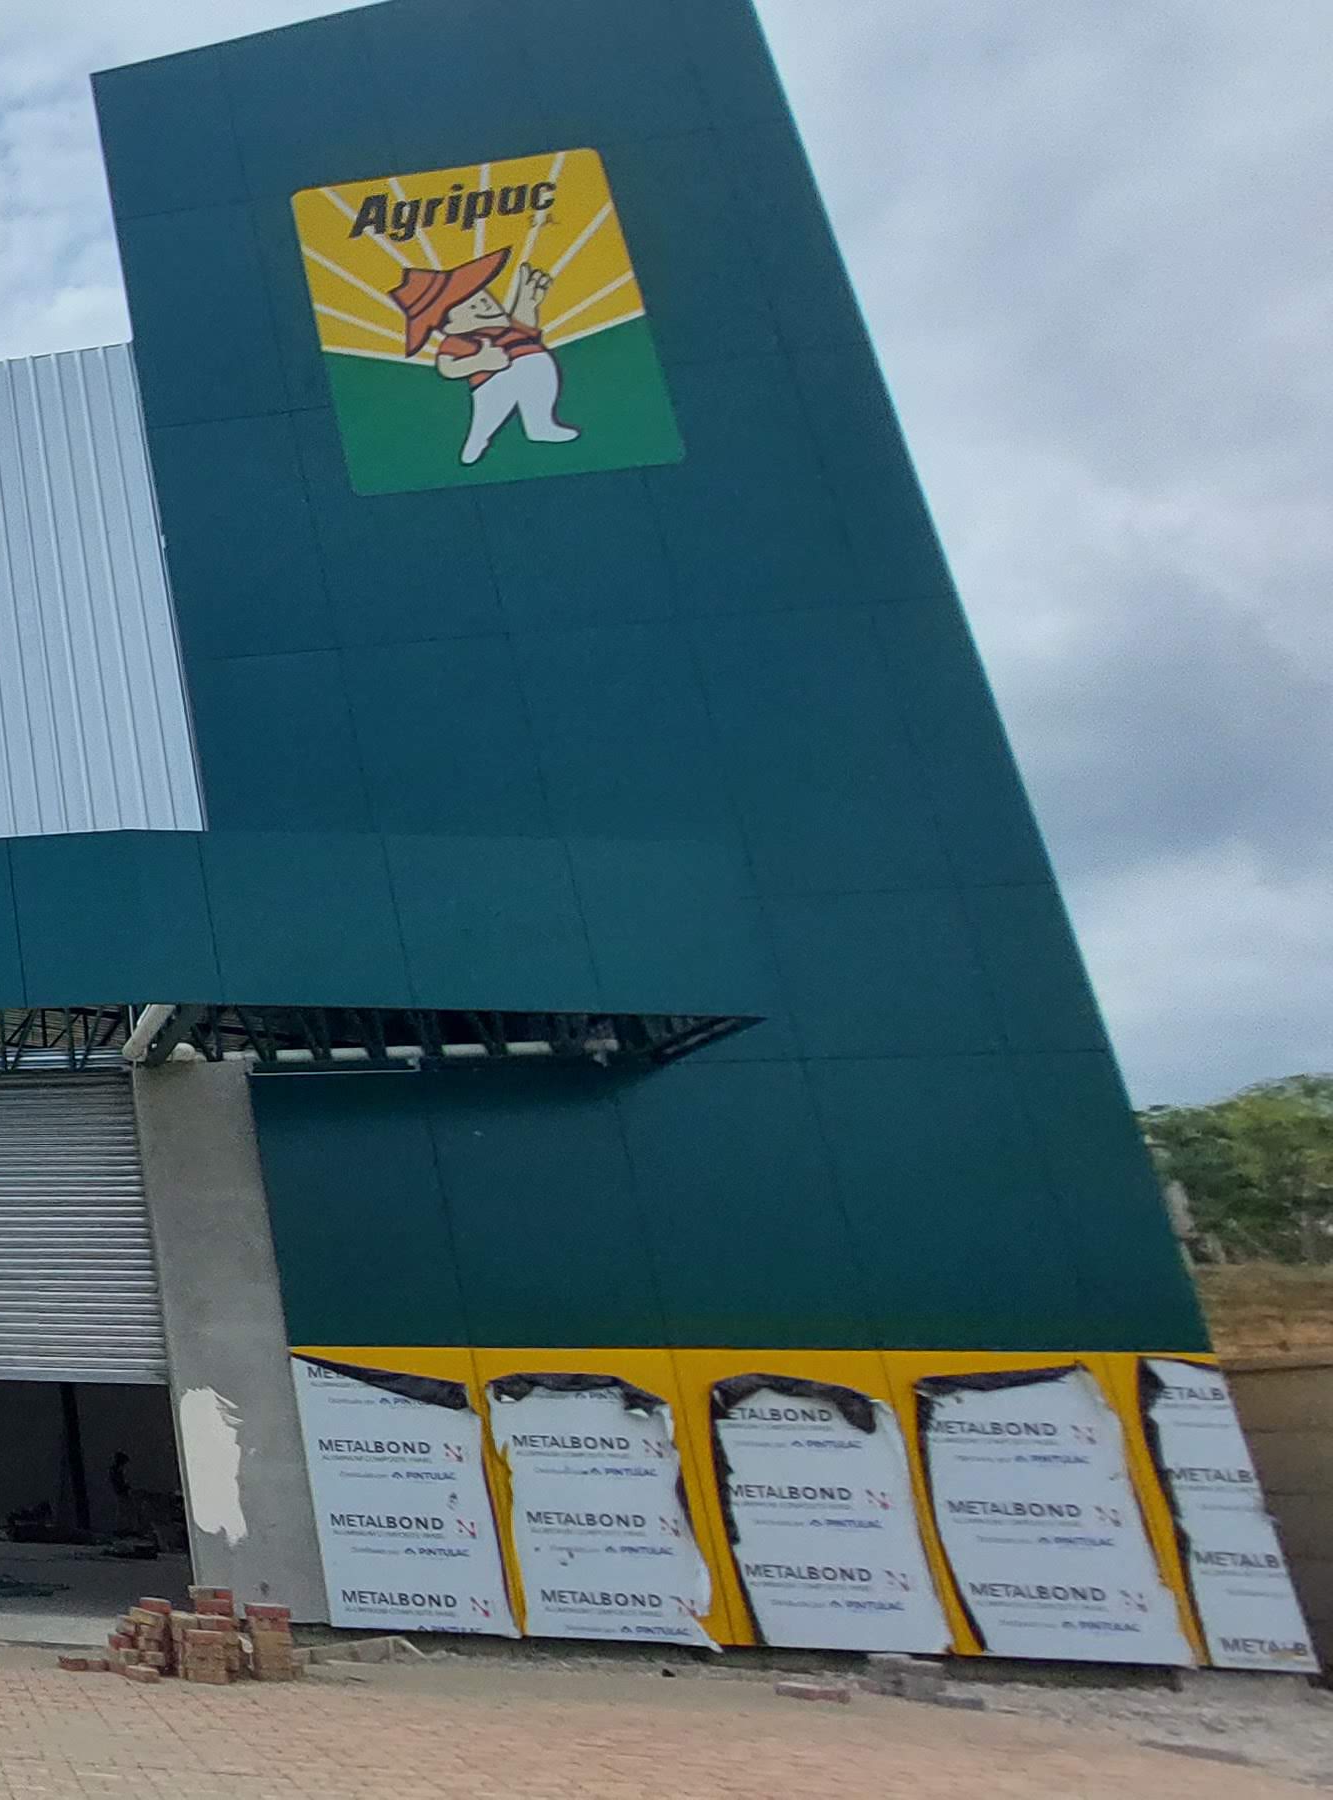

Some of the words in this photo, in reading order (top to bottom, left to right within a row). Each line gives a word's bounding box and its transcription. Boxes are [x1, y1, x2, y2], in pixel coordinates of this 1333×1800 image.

[349, 181, 557, 242] Agripac
[318, 1439, 432, 1455] METALBOND
[512, 1434, 630, 1450] METALBOND
[729, 1484, 852, 1501] METALBOND
[948, 1500, 1082, 1518] METALBOND
[330, 1513, 445, 1531] METALBOND
[526, 1511, 647, 1528] METALBOND
[744, 1563, 872, 1582] METALBOND
[341, 1589, 458, 1608] METALBOND
[540, 1589, 663, 1608] METALBOND
[968, 1582, 1106, 1602] METALBOND
